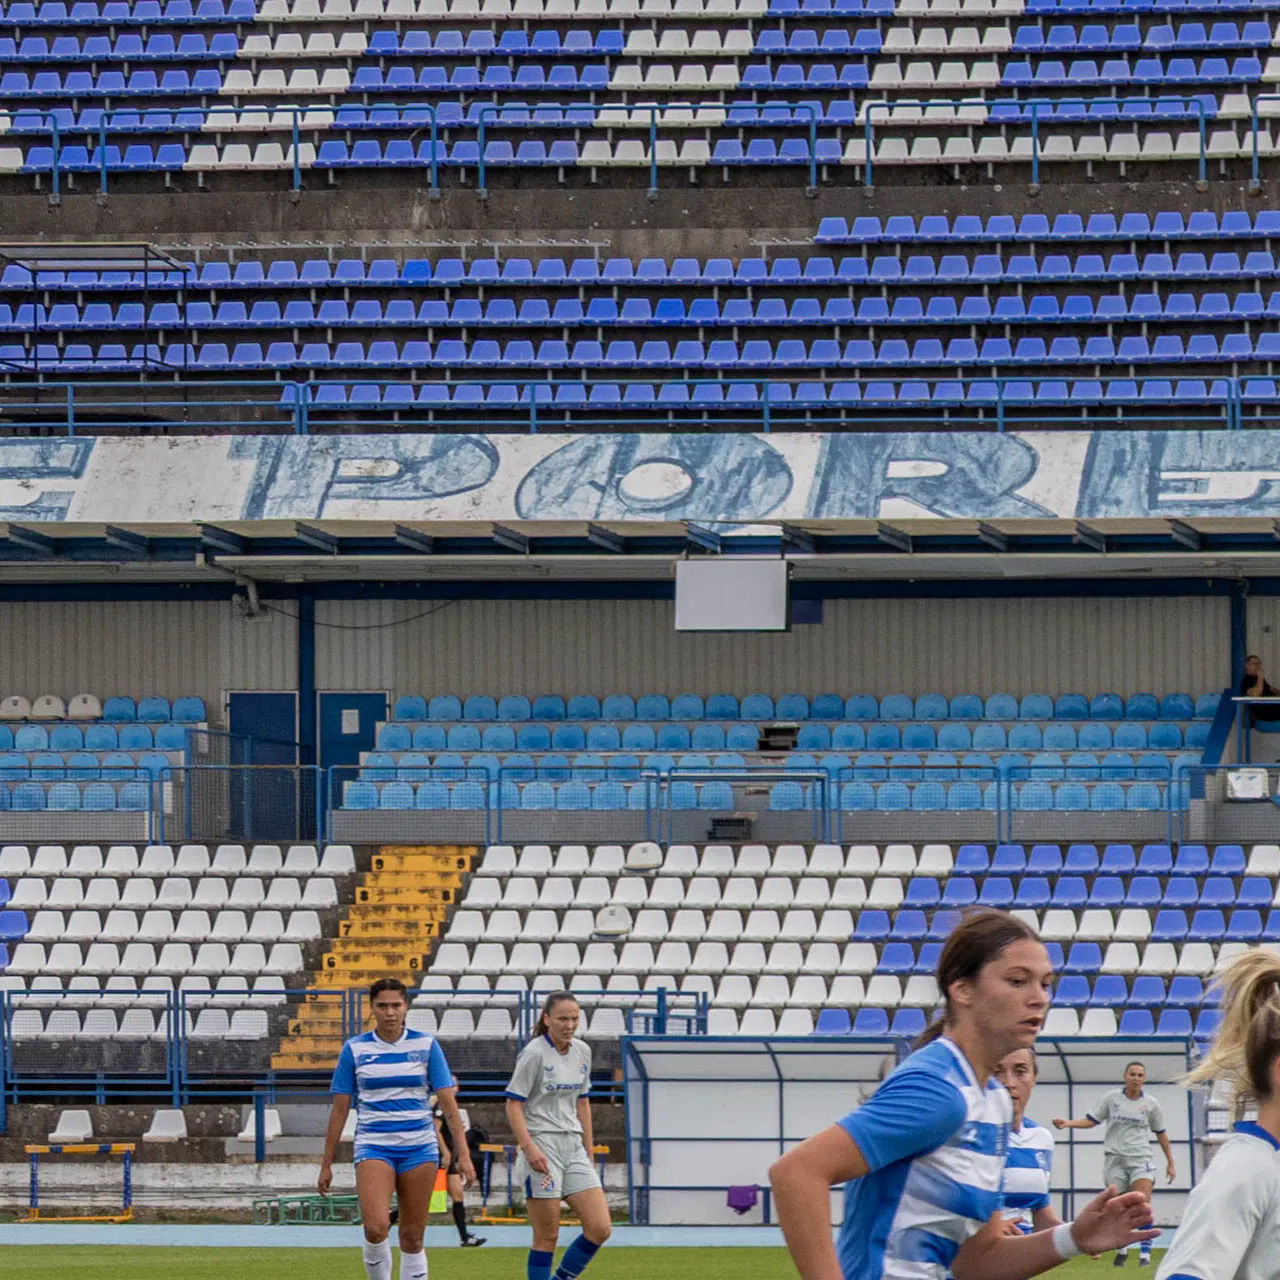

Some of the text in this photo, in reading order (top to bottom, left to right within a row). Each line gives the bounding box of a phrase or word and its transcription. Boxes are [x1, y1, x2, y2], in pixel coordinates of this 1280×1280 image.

[342, 924, 434, 936] 7 7
[327, 957, 418, 969] 6 6
